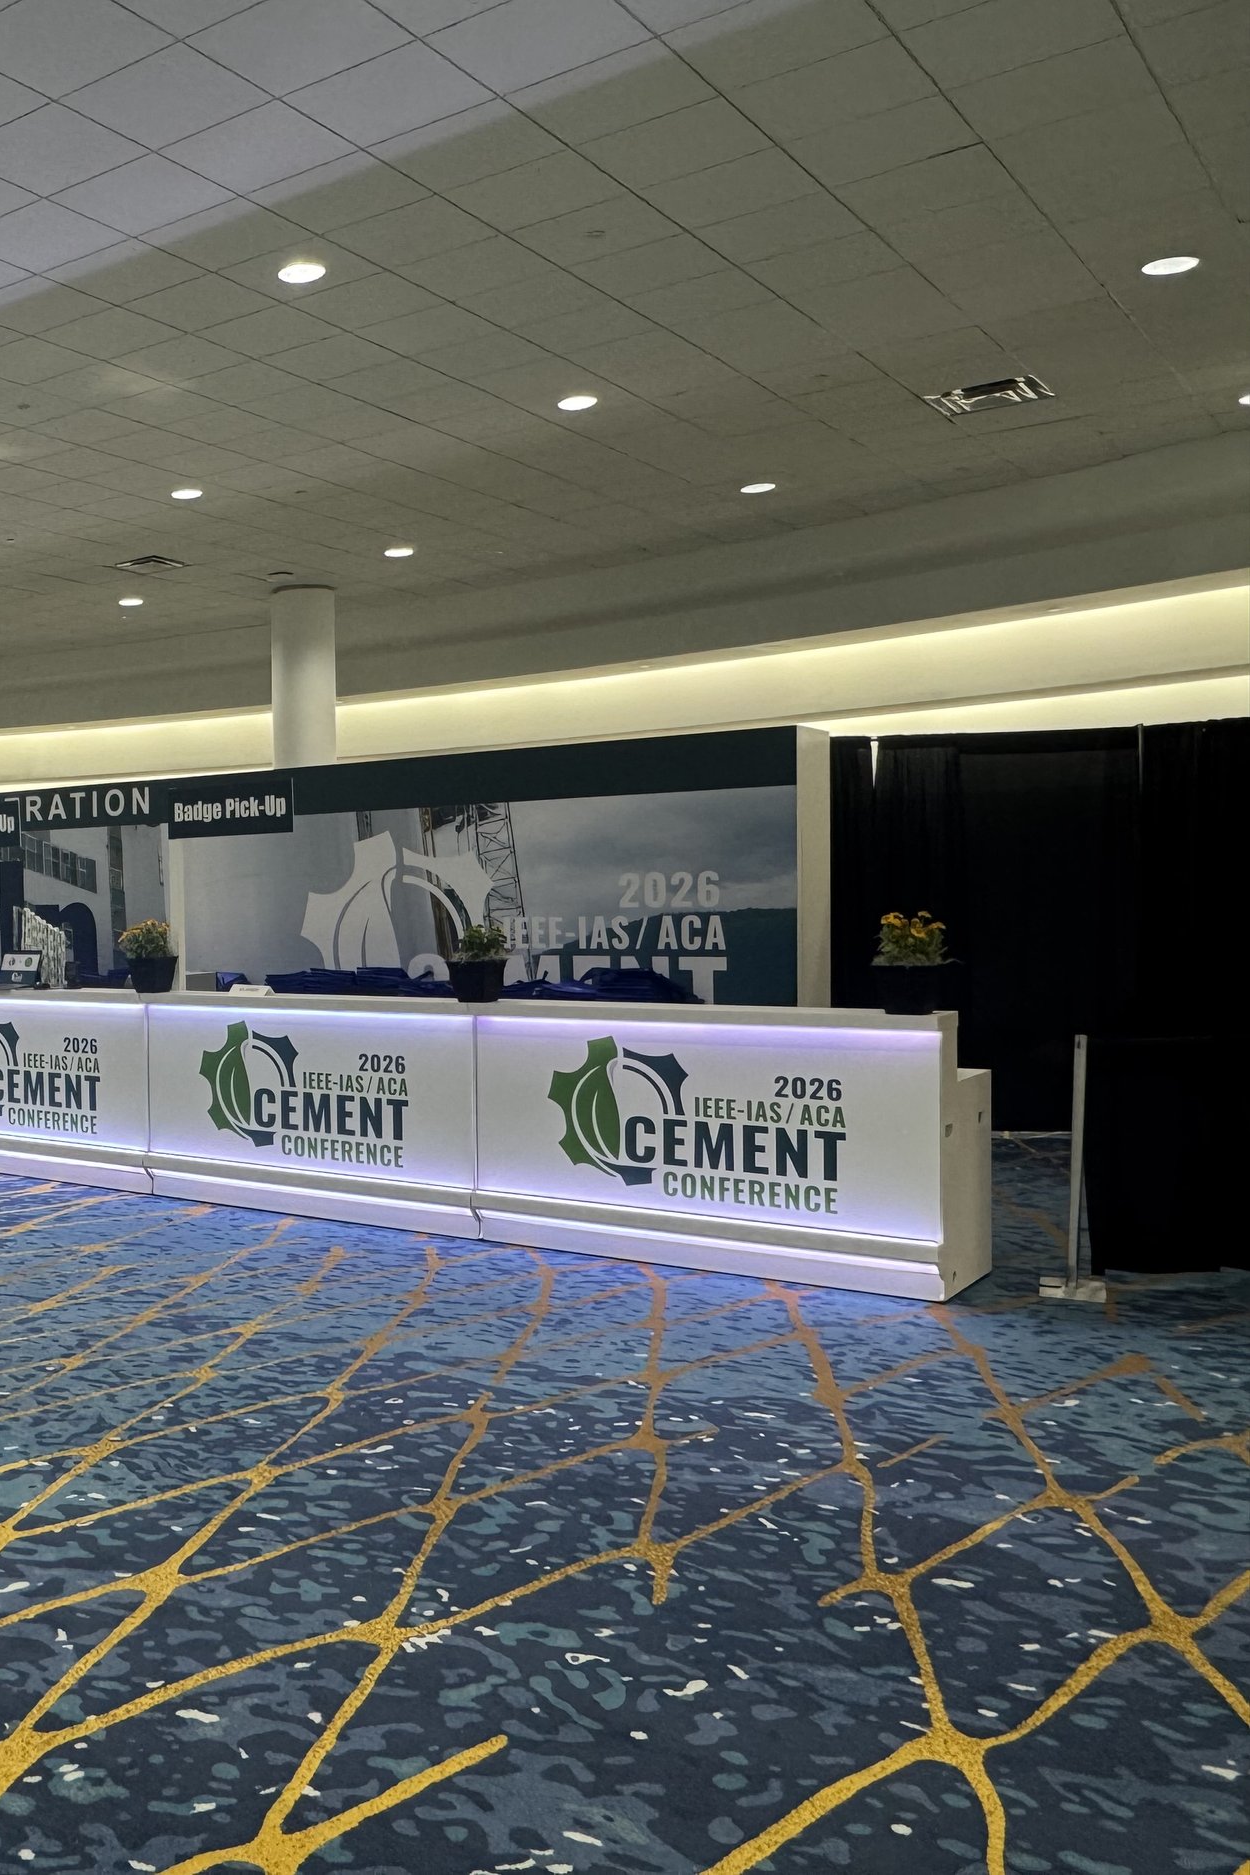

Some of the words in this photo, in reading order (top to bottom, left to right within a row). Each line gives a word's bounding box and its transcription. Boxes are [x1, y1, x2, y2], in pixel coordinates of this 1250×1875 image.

[174, 800, 222, 823] Badge
[225, 794, 287, 819] Pick-Up
[618, 871, 720, 908] 2026
[63, 1037, 98, 1054] 2026
[358, 1053, 406, 1075] 2026
[774, 1075, 842, 1101] 2026
[8, 1107, 98, 1134] CONFERENCE
[253, 1088, 409, 1141] CEMENT
[281, 1134, 404, 1169] CONFERENCE
[624, 1115, 847, 1182] CEMENT
[662, 1171, 839, 1215] CONFERENCE
